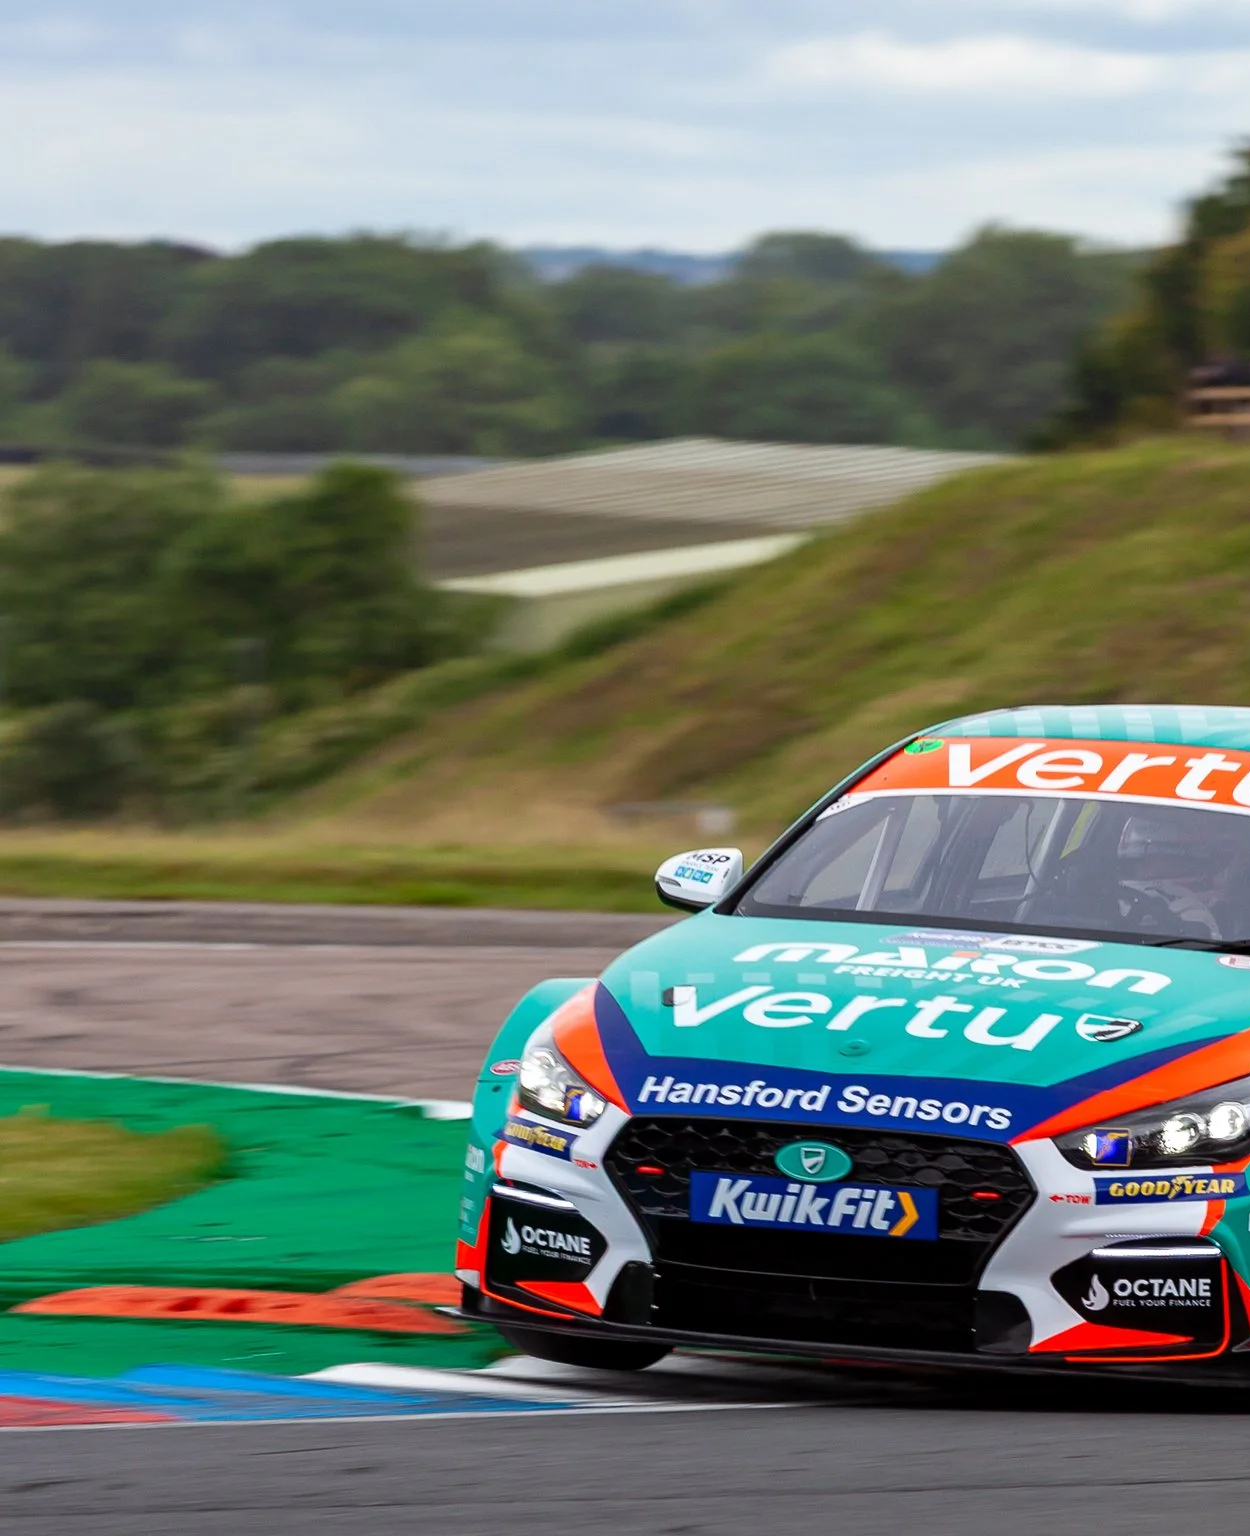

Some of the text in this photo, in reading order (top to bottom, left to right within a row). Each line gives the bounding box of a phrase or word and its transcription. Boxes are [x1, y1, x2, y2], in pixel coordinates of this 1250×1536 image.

[976, 975, 1028, 989] UK
[672, 984, 1063, 1052] Vertu
[637, 1076, 1013, 1131] Hansford Sensors
[1065, 1194, 1091, 1204] TOW
[521, 1225, 592, 1256] OCTANE
[1113, 1278, 1212, 1297] OCTANE
[1113, 1299, 1212, 1307] FUEL YOUR FINANCE
